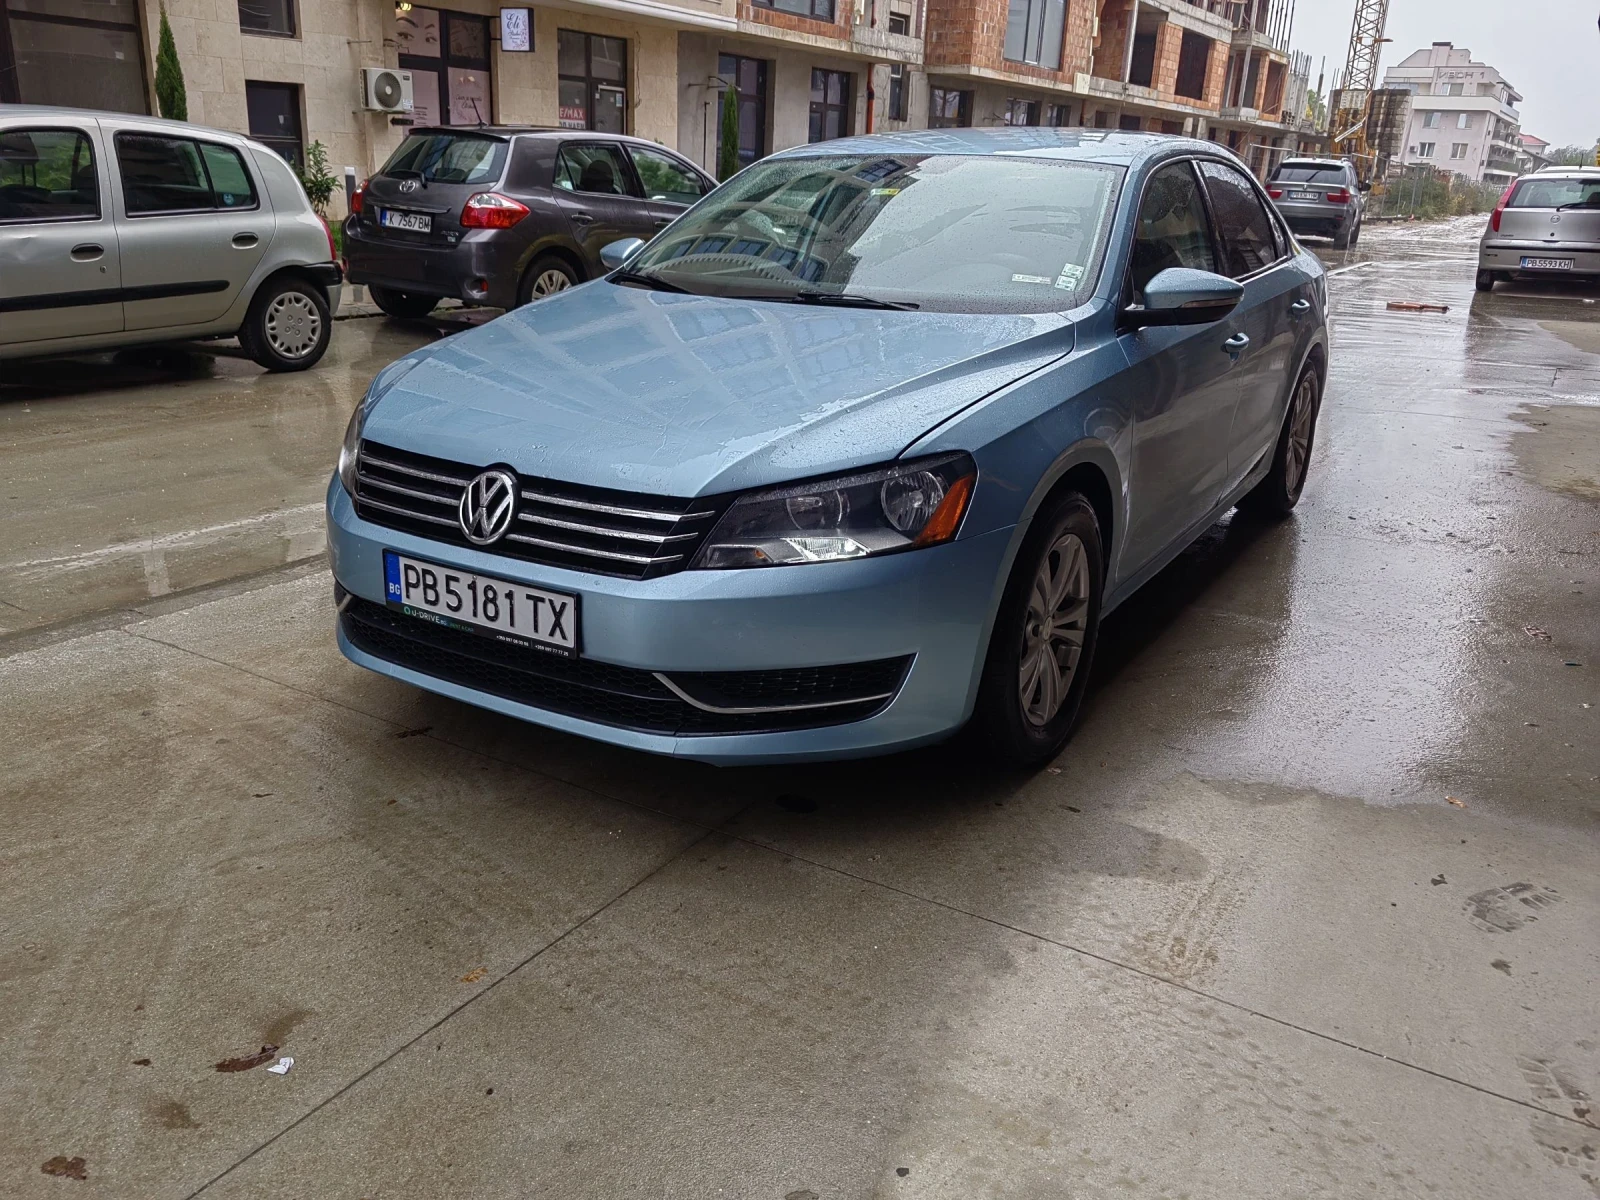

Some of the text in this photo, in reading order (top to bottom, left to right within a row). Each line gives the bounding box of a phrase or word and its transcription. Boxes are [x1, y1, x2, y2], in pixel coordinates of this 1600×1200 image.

[506, 13, 520, 29] Eli
[1480, 71, 1485, 79] 1
[560, 108, 584, 119] E/MAX
[389, 213, 394, 226] K
[389, 582, 401, 595] BG
